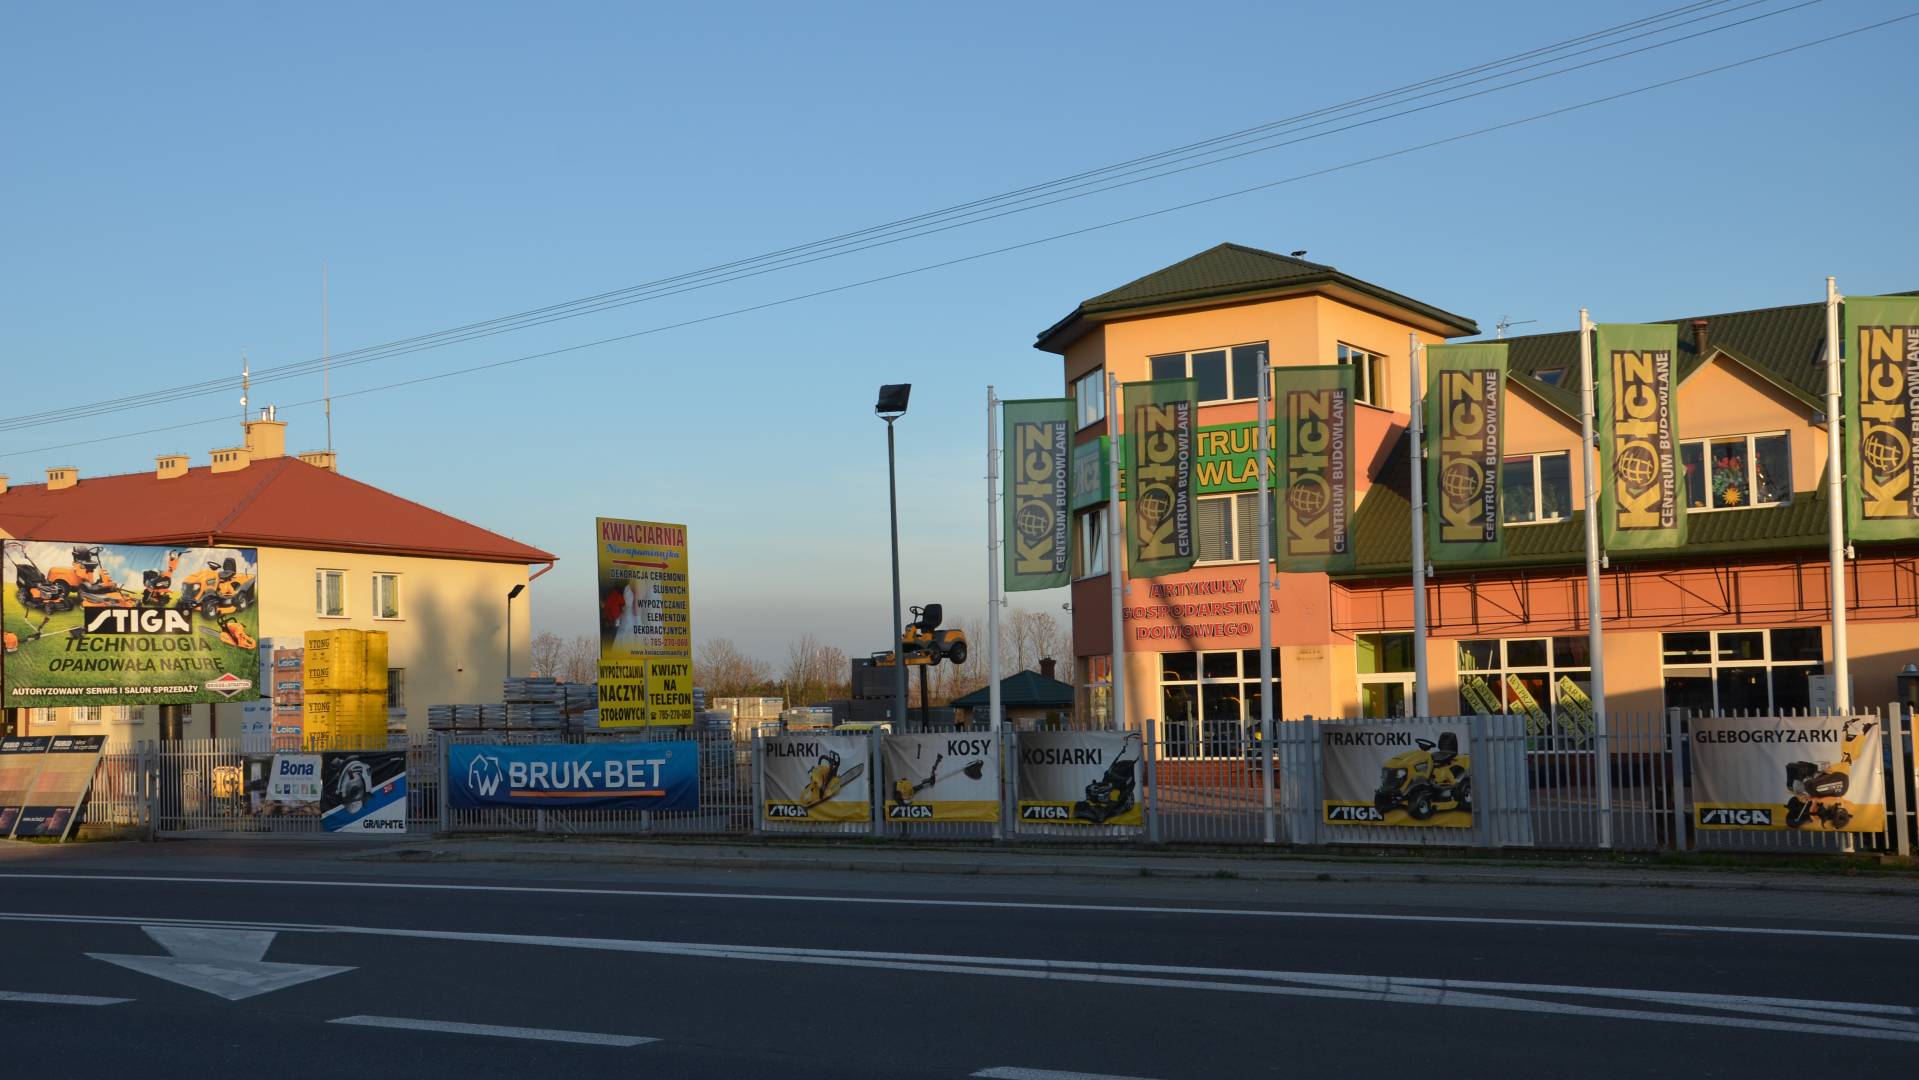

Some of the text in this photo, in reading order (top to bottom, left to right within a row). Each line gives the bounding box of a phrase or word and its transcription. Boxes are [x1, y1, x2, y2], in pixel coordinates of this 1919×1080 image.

[1655, 352, 1674, 528] CENTRUM BUDOWLANE
[1484, 371, 1497, 541] CENTRUM BUDOWLANE
[1332, 390, 1345, 553] CENTRUM BUDOWLANE
[1175, 402, 1189, 556] CENTRUM BUDOWLANE
[1055, 423, 1067, 572] CENTRUM BUDOWLANE
[602, 522, 684, 546] KWIACIARNIA
[611, 569, 649, 580] DEKORACJA
[87, 609, 190, 634] STIGA
[633, 625, 687, 635] DEKORACYJNYCH
[1136, 622, 1254, 641] DOMOWEGO
[65, 637, 212, 652] TECHNOLOGIA
[309, 639, 330, 649] YTONG
[48, 657, 225, 673] OPANOWAŁA NATURĘ
[651, 664, 688, 676] KWIATY
[309, 668, 329, 677] YTONG
[12, 686, 84, 696] AUTORYZOWANY
[86, 687, 117, 695] SERWIS
[125, 686, 152, 695] SALON
[153, 685, 198, 695] SPRZEDAŻY
[600, 681, 645, 702] NACZYŃ
[663, 680, 677, 691] NA
[309, 702, 330, 711] YTONG
[649, 693, 691, 706] TELEFON
[600, 707, 645, 721] STOŁOWYCH
[1324, 732, 1411, 746] TRAKTORKI
[1696, 729, 1838, 743] GLEBOGRYZARKI
[766, 742, 819, 757] PILARKI
[947, 739, 991, 756] KOSY
[1022, 748, 1101, 764] KOSIARKI
[280, 760, 314, 775] Bona
[509, 758, 666, 788] BRUK-BET
[769, 804, 807, 816] STIGA
[890, 805, 932, 818] STIGA
[1023, 806, 1069, 818] STIGA
[1329, 806, 1383, 820] STIGA
[1702, 809, 1769, 825] STIGA
[363, 819, 404, 829] GRAPHITE
